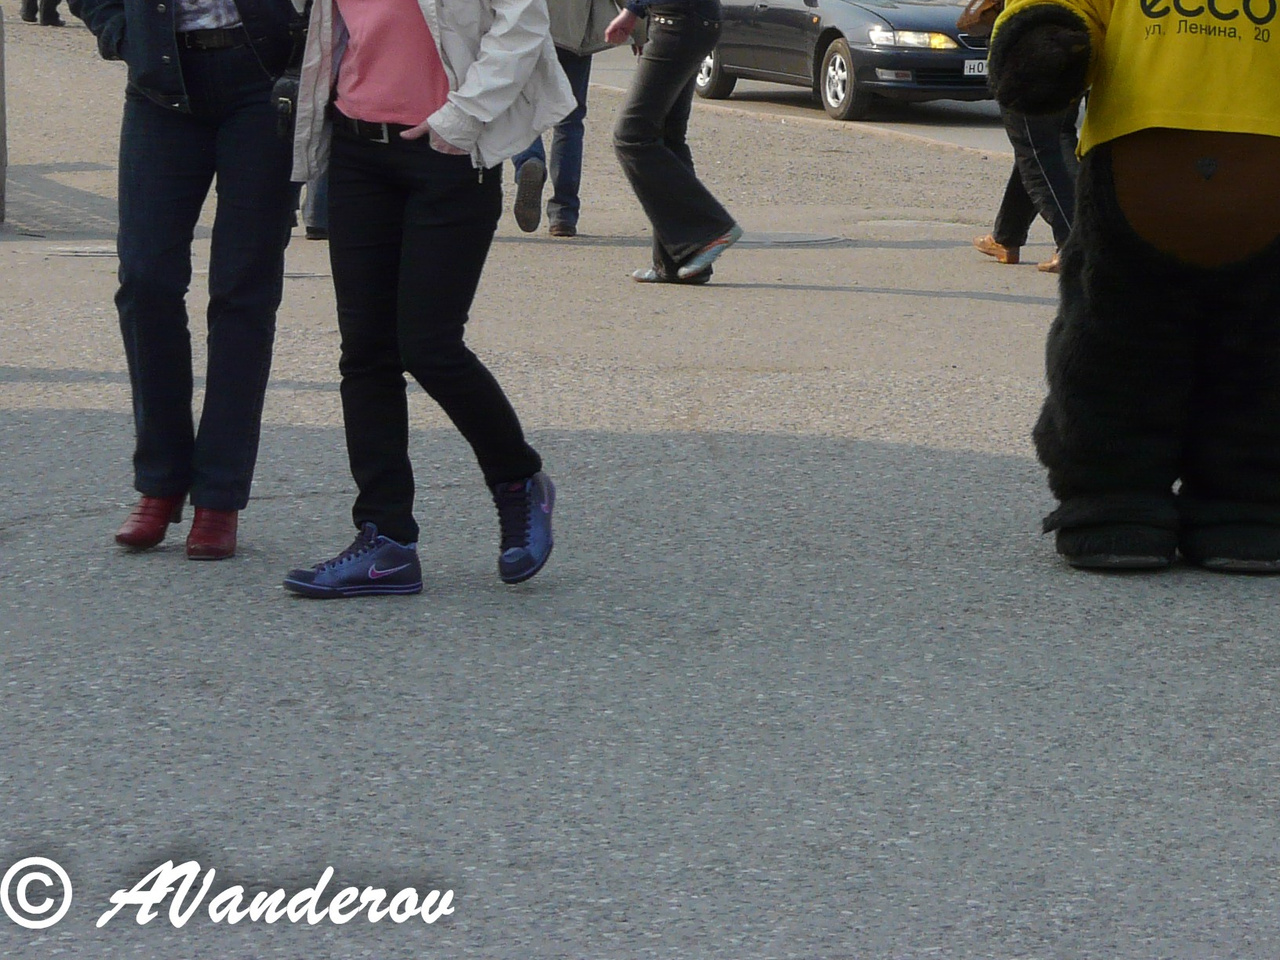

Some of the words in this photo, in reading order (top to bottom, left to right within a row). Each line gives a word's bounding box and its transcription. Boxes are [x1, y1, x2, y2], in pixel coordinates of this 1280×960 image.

[1145, 24, 1166, 40] ул.
[1177, 20, 1242, 42] Ленина,
[1254, 26, 1271, 43] 20
